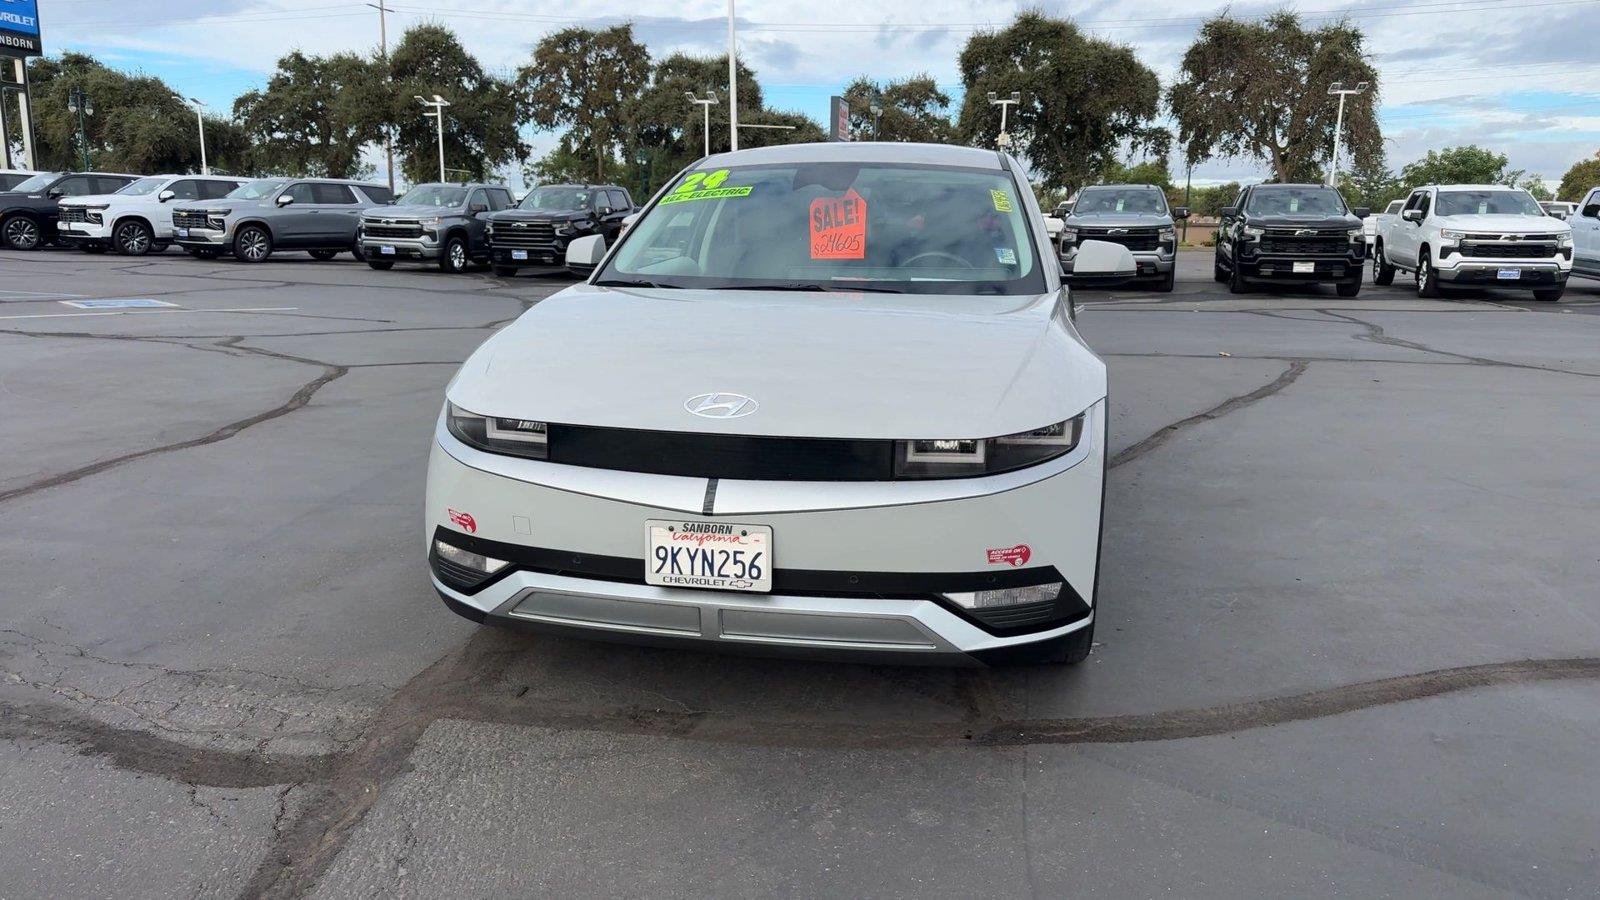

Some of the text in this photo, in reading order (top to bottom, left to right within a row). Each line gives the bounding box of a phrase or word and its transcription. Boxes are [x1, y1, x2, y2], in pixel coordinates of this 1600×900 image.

[814, 199, 860, 233] SALE!
[682, 522, 733, 535] SANBORN
[672, 532, 747, 546] California
[655, 545, 763, 580] 9KYN256
[663, 575, 727, 587] CHEVROLET
